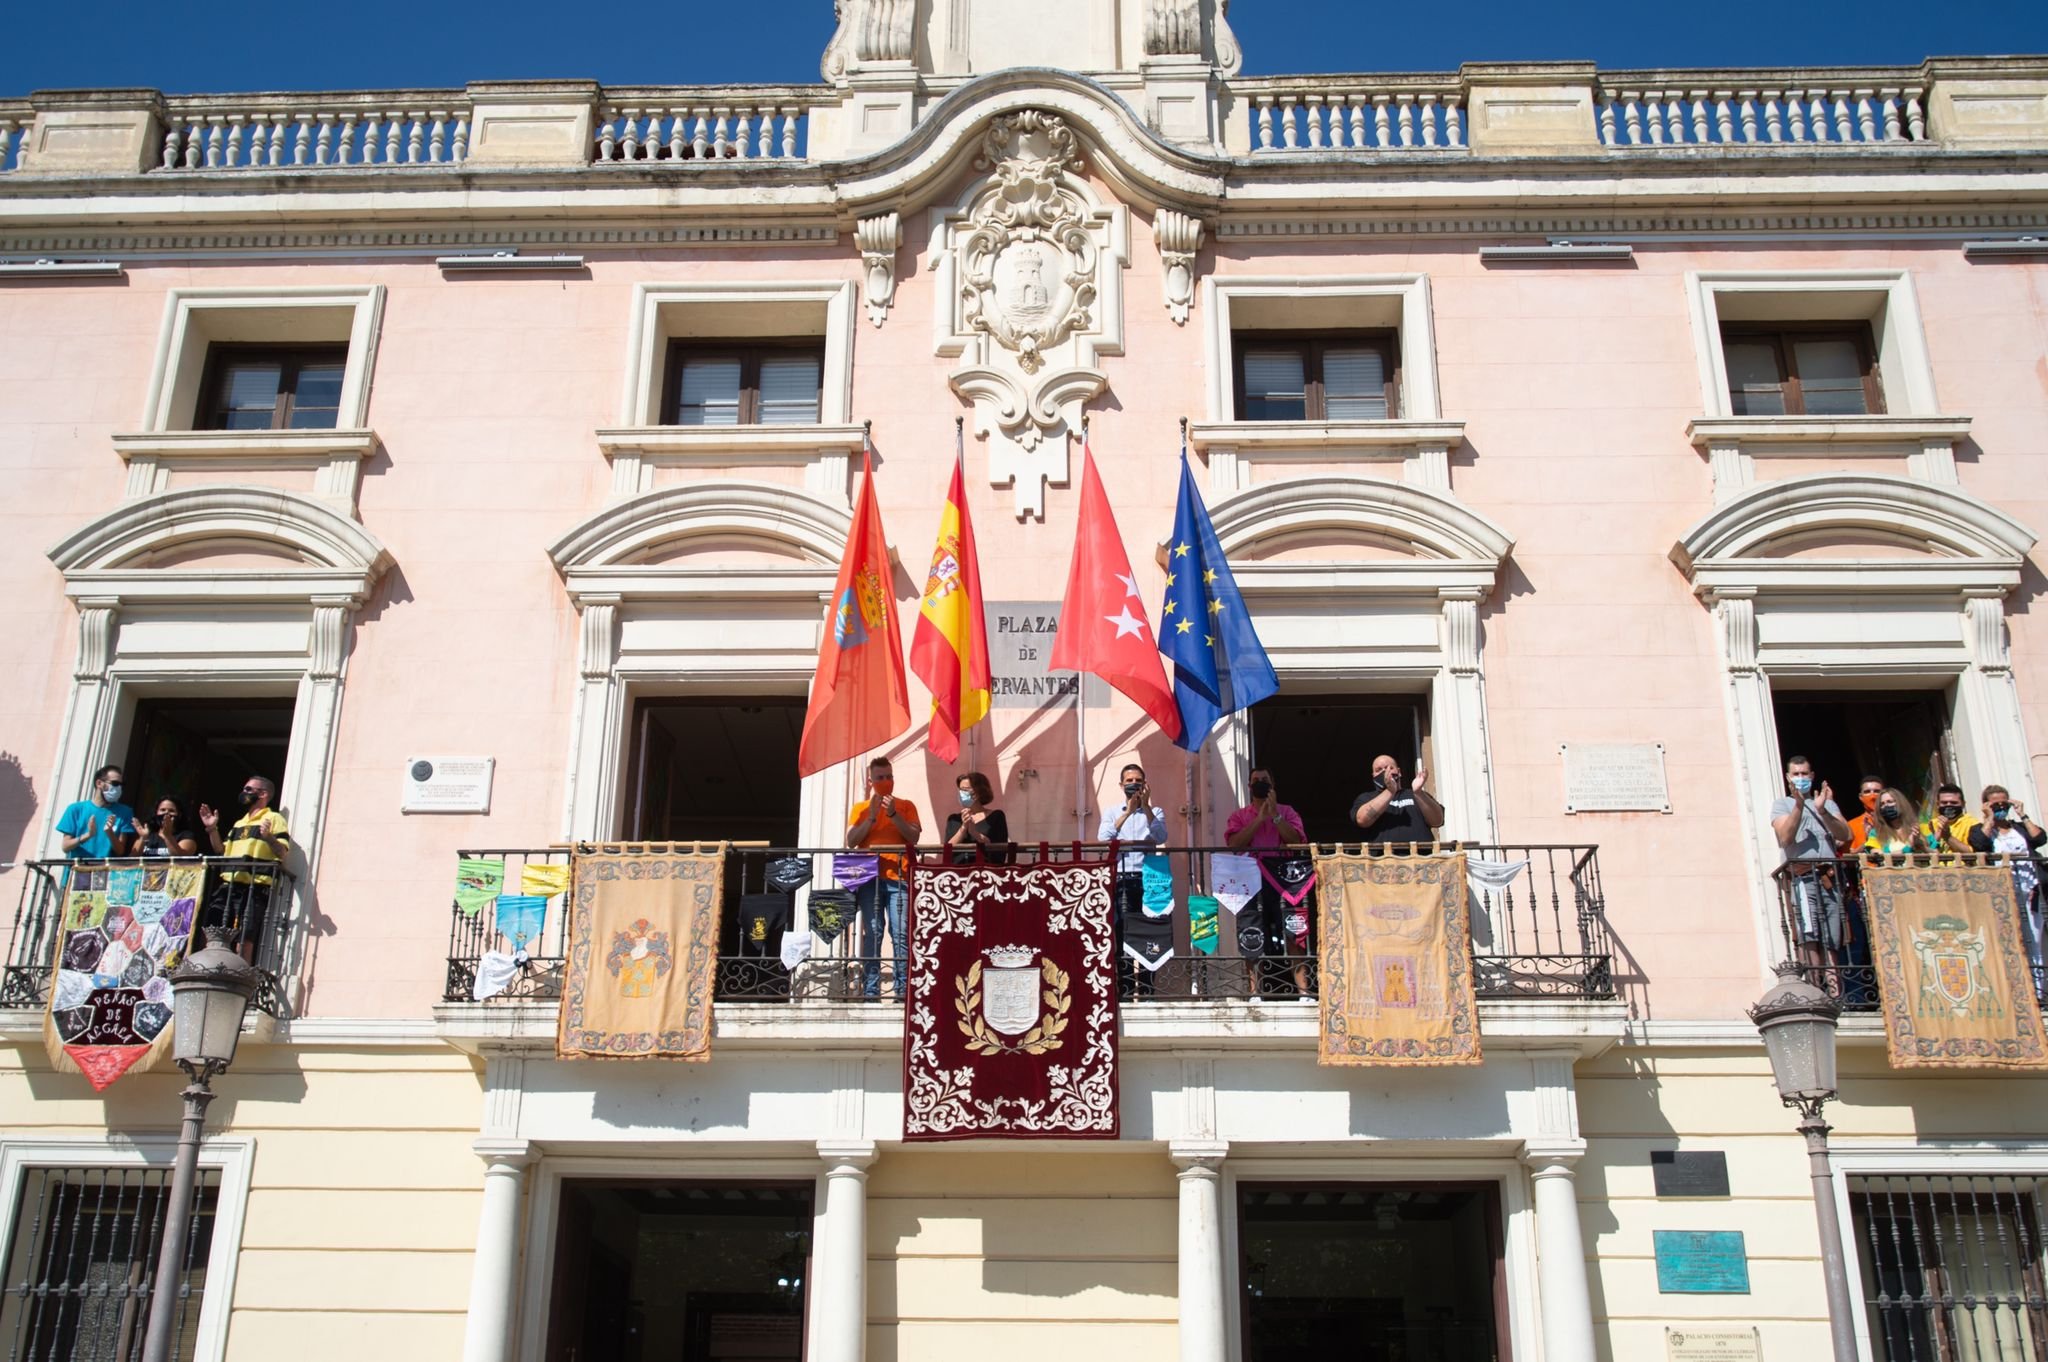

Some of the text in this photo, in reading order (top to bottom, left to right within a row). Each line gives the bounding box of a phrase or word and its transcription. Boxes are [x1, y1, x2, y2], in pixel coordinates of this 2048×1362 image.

[998, 616, 1058, 633] PLAZA
[1018, 648, 1037, 660] DE
[991, 676, 1079, 695] ERVANTES
[94, 990, 136, 1007] PEÑAS
[106, 1008, 121, 1021] DE
